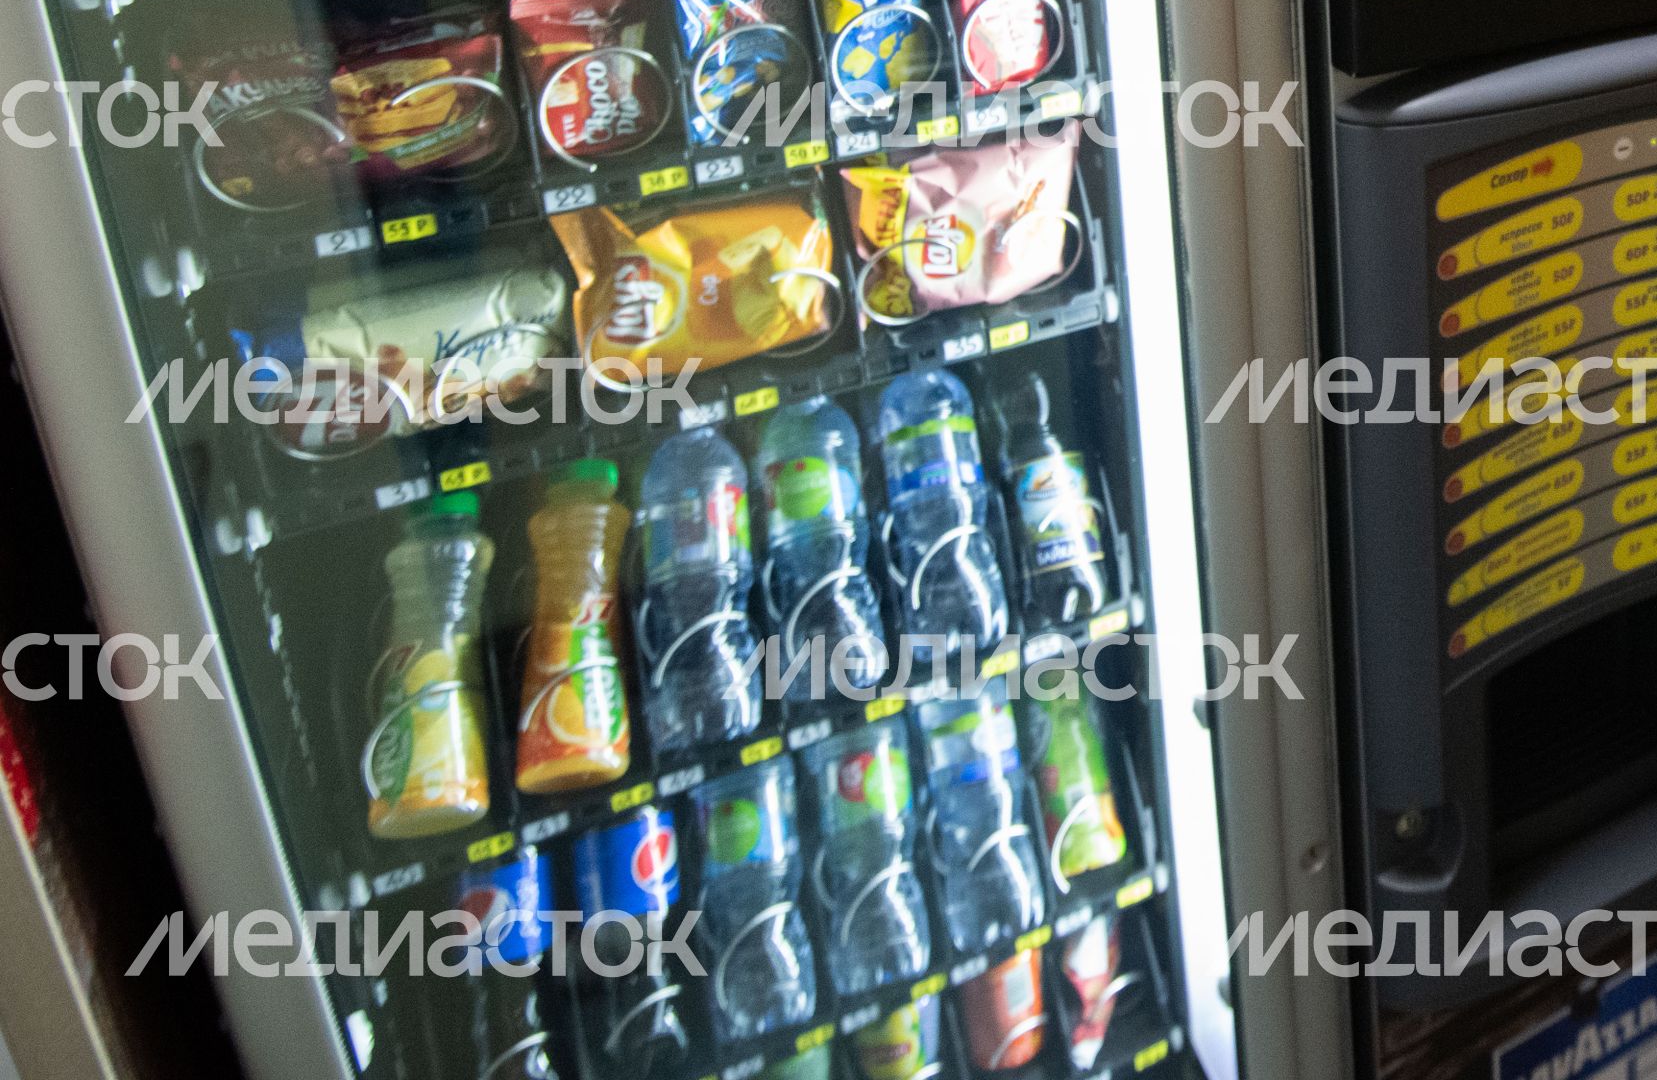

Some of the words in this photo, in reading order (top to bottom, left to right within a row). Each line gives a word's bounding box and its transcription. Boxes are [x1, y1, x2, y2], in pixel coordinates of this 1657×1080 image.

[975, 108, 999, 128] 25
[846, 134, 874, 153] 24
[705, 160, 734, 180] 23
[1490, 167, 1529, 189] Сахар
[553, 187, 586, 208] 22
[387, 220, 411, 240] 55
[331, 229, 364, 253] 21
